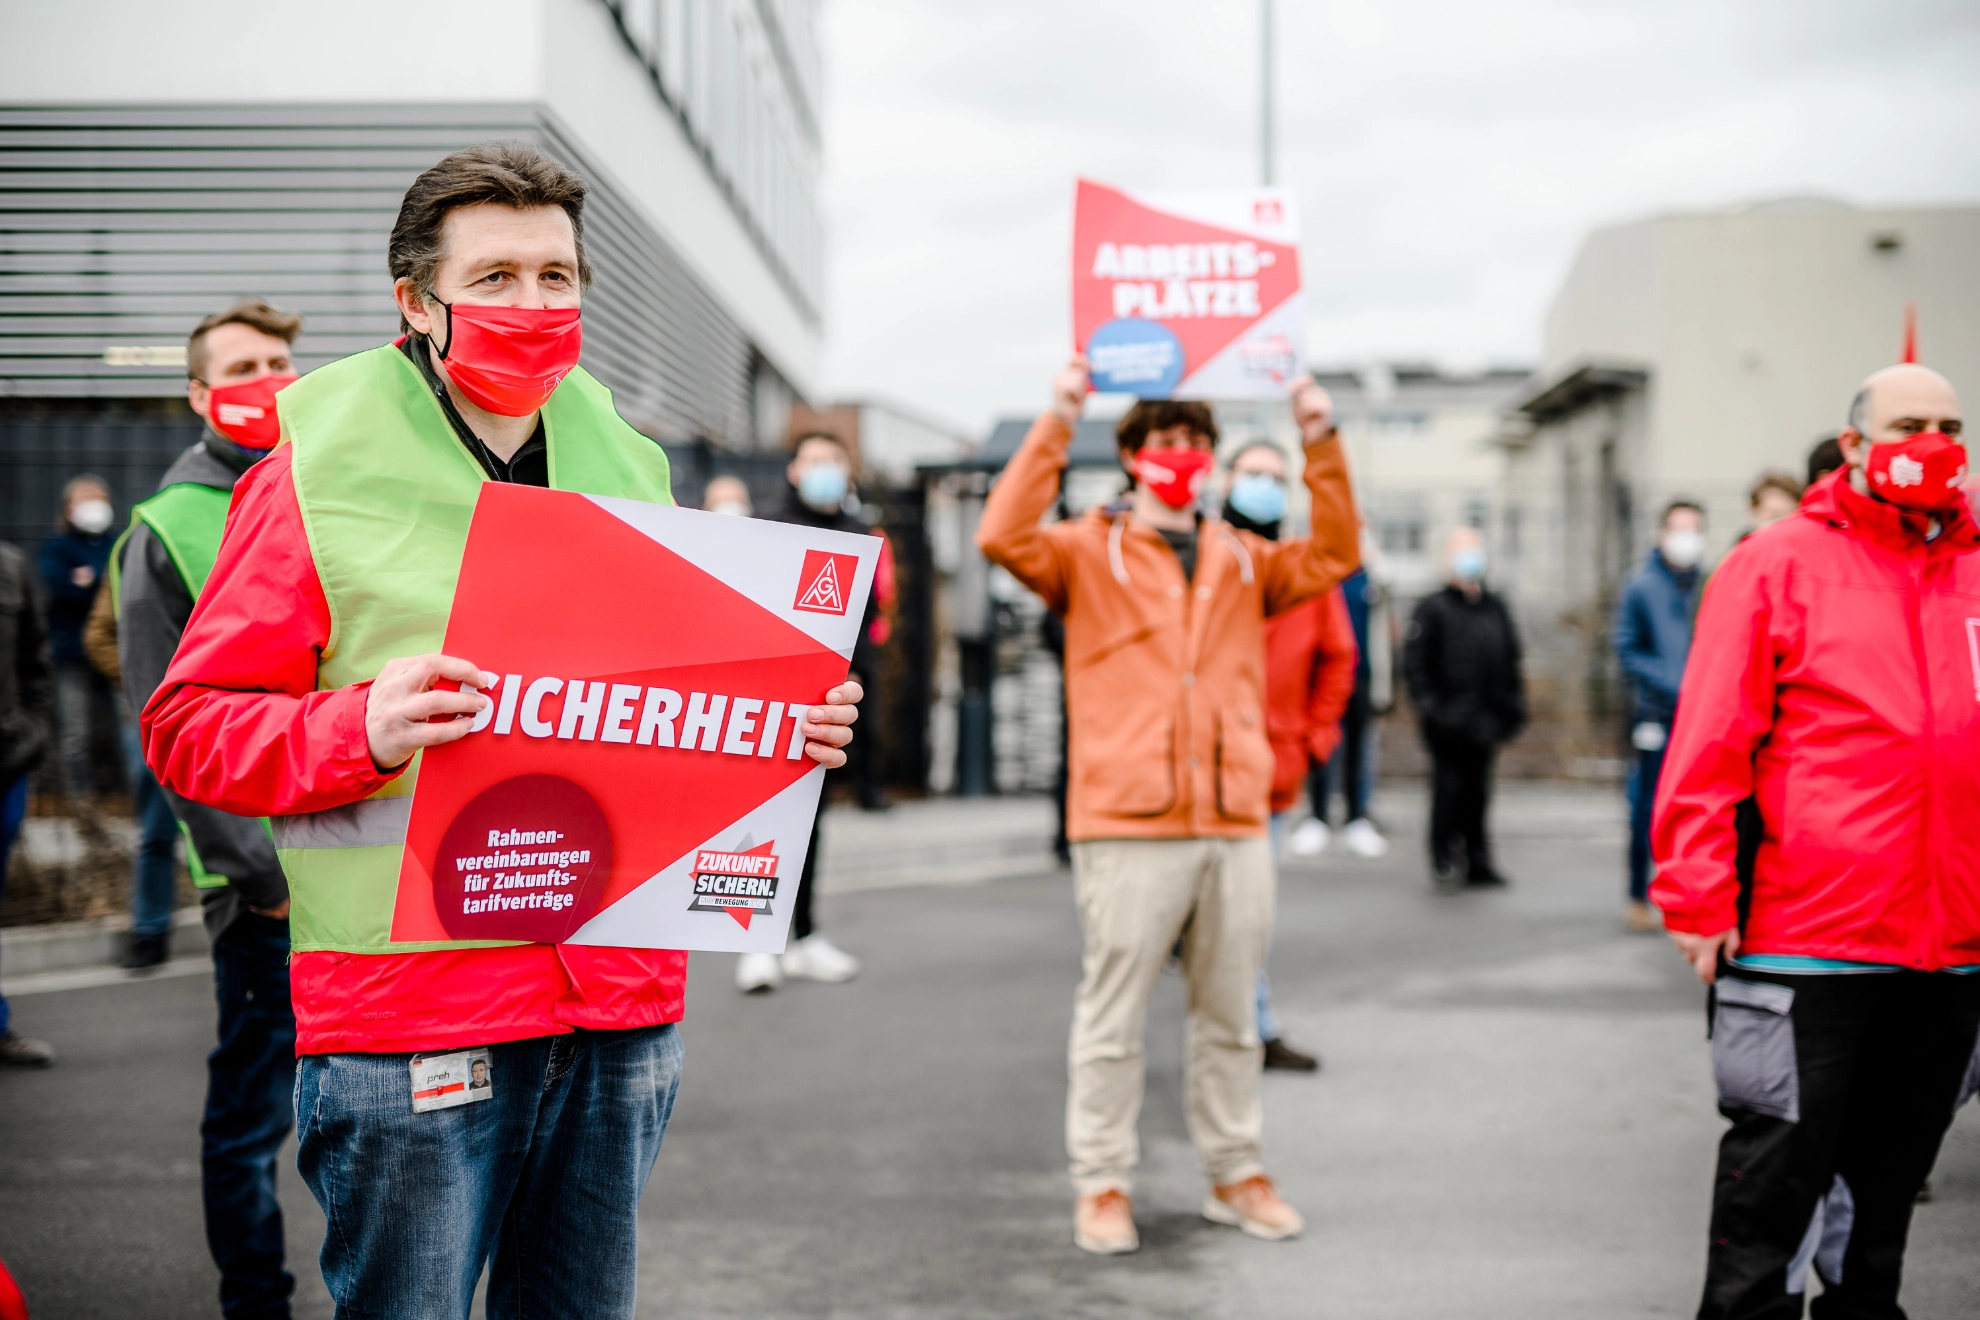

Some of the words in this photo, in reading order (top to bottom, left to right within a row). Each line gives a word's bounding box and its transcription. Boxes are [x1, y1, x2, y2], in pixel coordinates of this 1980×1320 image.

[1092, 242, 1276, 280] ARBEITS-
[1112, 275, 1261, 317] PLÄTZE
[487, 828, 564, 847] Rahmen-
[456, 849, 591, 872] vereinbarungen
[697, 852, 776, 875] ZUKUNFT
[463, 873, 490, 893] für
[492, 868, 577, 890] Zukunfts-
[695, 874, 775, 897] SICHERN.
[463, 890, 574, 914] tarifverträge
